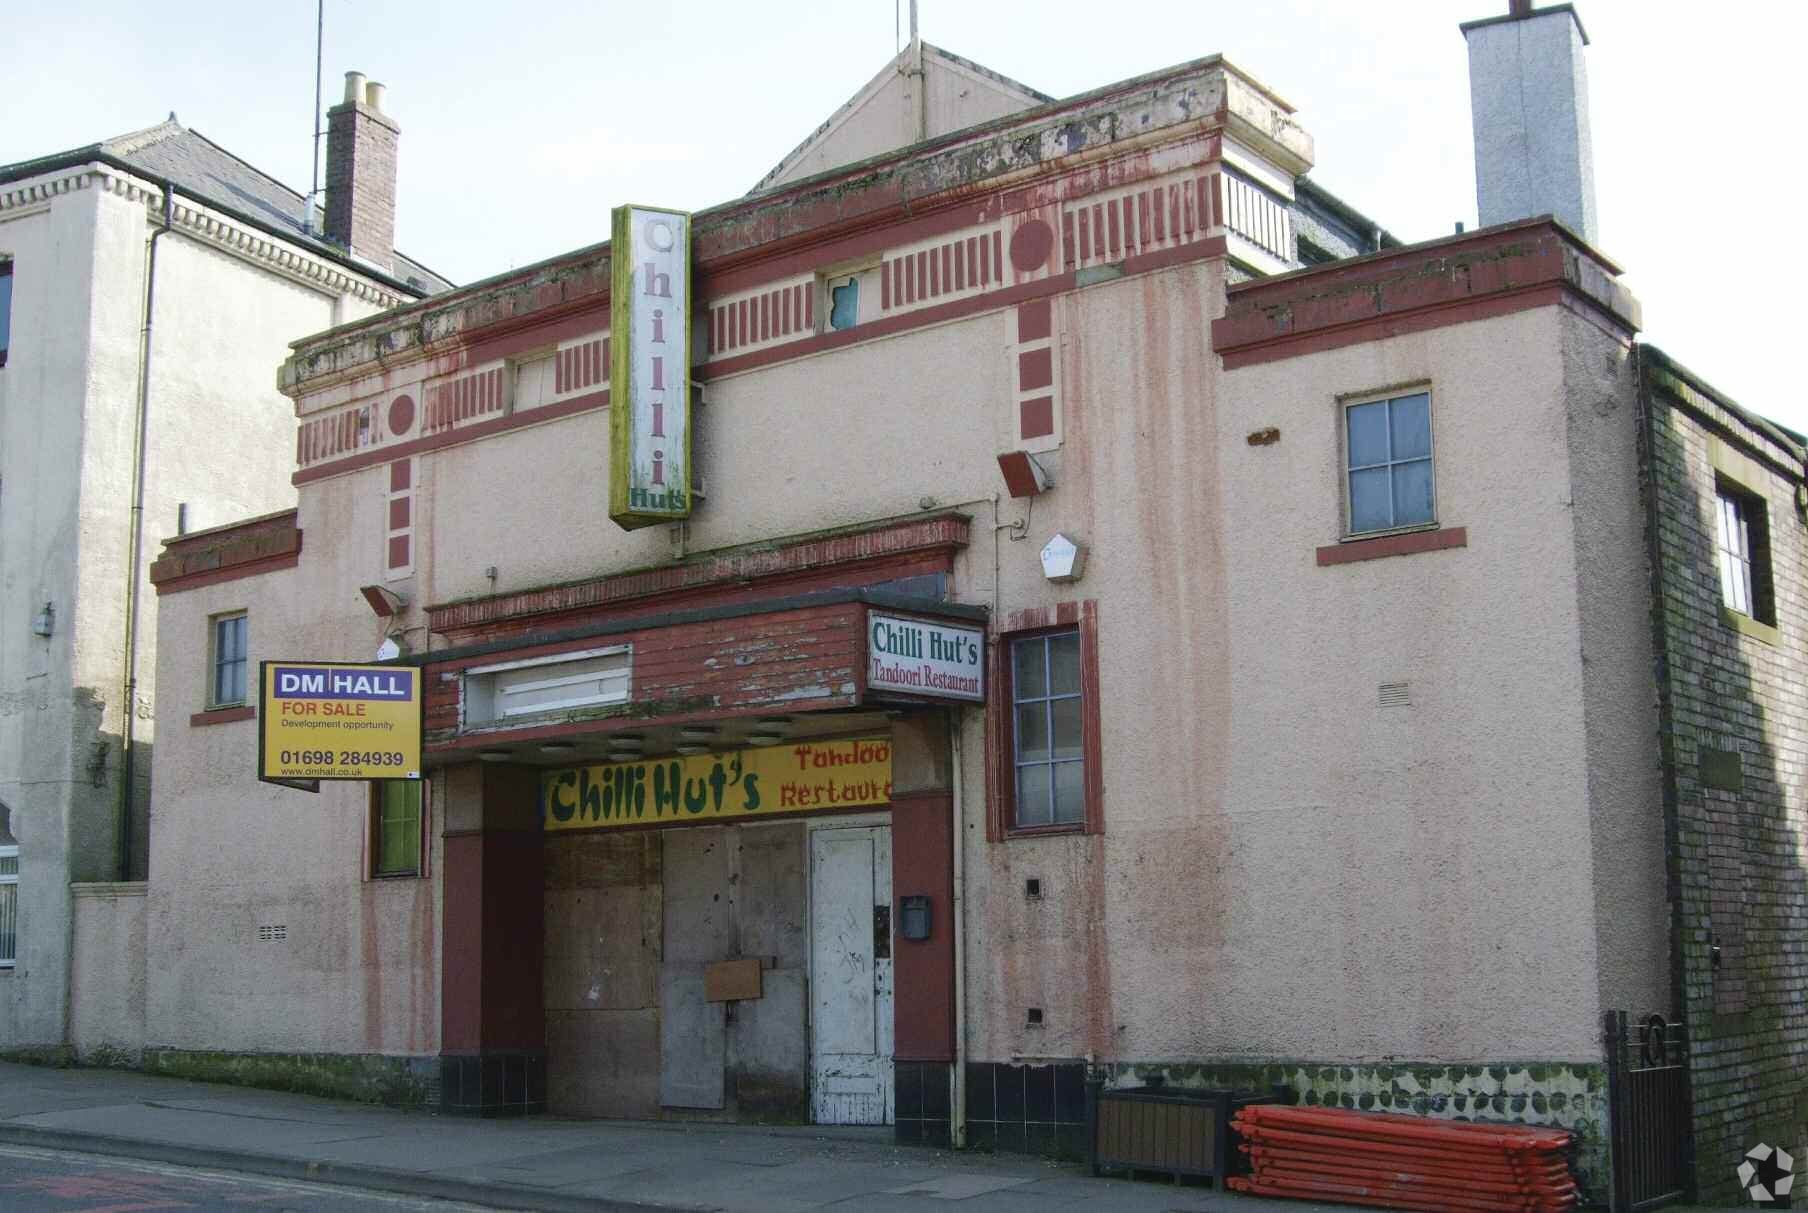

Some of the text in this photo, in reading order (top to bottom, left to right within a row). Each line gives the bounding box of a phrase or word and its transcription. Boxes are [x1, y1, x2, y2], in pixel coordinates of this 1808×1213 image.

[872, 621, 978, 666] Chilli Hut's
[280, 673, 405, 695] DM HALL
[872, 657, 979, 694] Tandoori Restaurant
[281, 701, 366, 717] FOR SALE
[281, 718, 394, 731] Development opportunity
[280, 750, 404, 766] 01698 284939
[280, 767, 363, 777] www.dmhall.co.uk
[551, 751, 761, 822] Chilli Hut's
